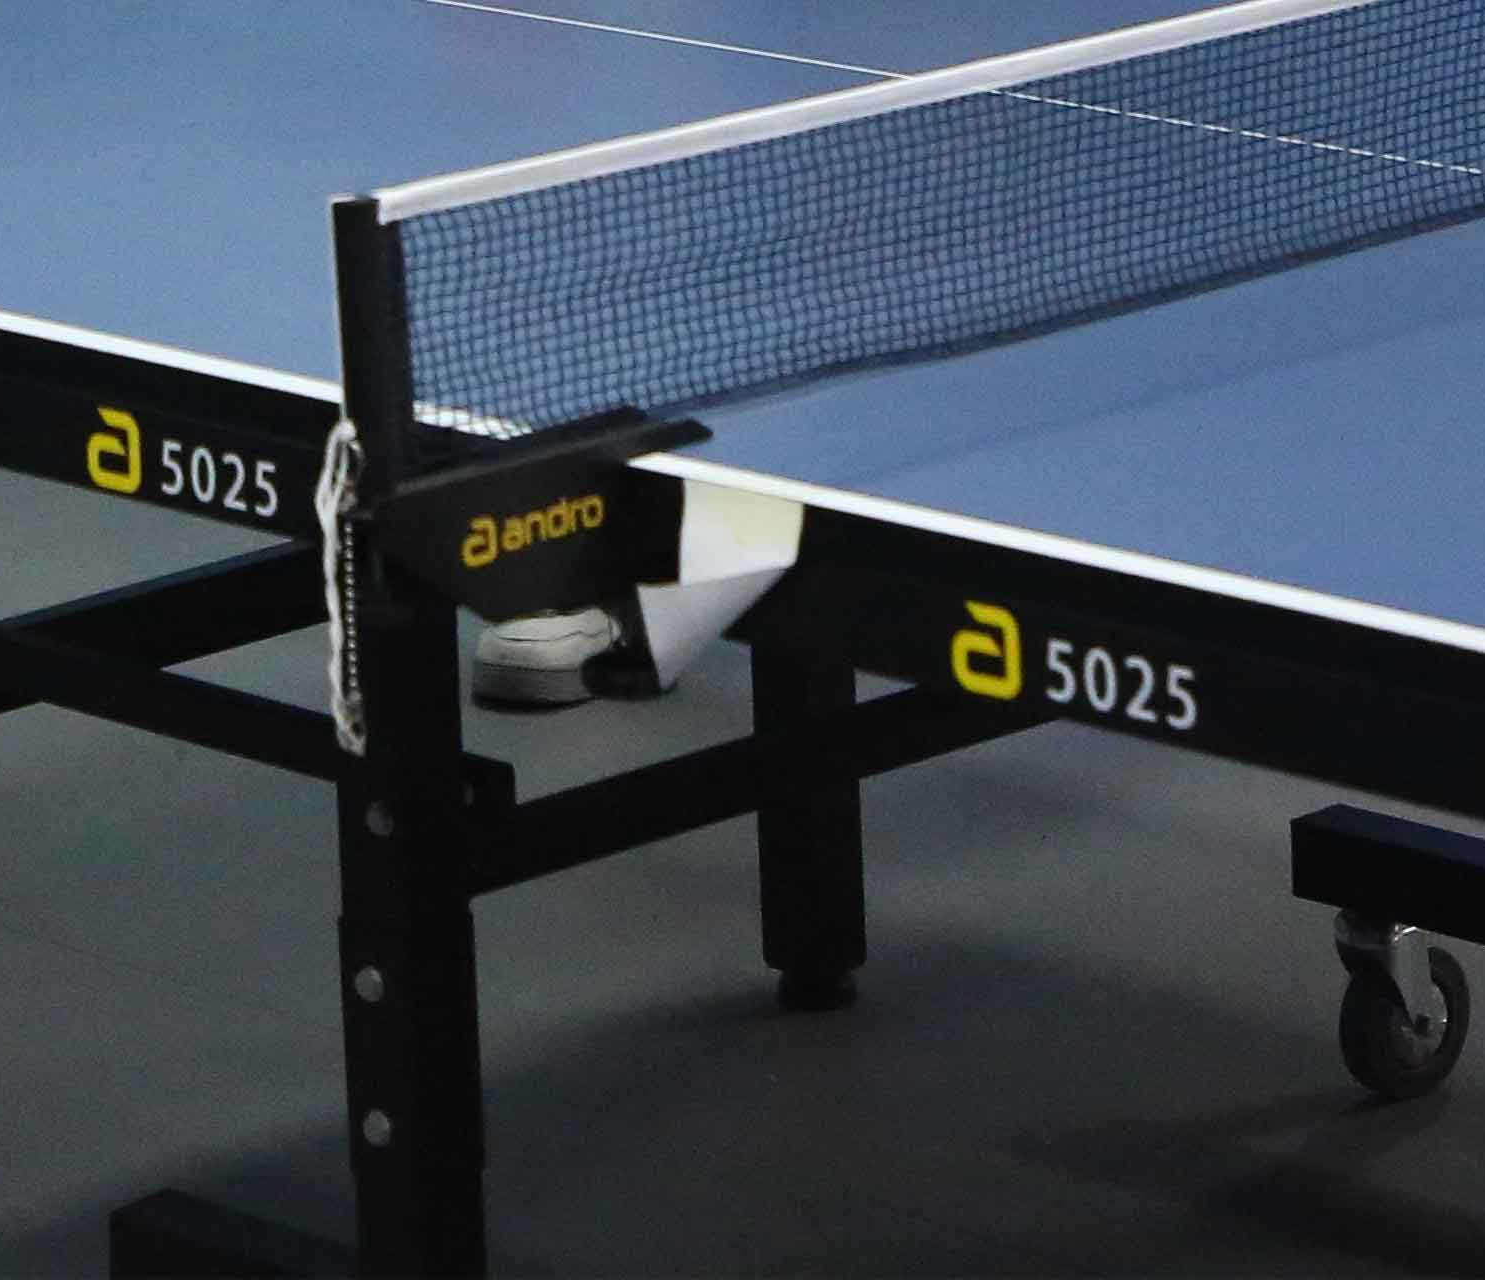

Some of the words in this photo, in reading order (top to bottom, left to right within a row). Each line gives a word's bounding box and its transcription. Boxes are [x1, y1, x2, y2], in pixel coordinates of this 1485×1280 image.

[160, 439, 280, 518] 5025
[502, 495, 605, 552] andro
[1045, 638, 1198, 731] 5025
